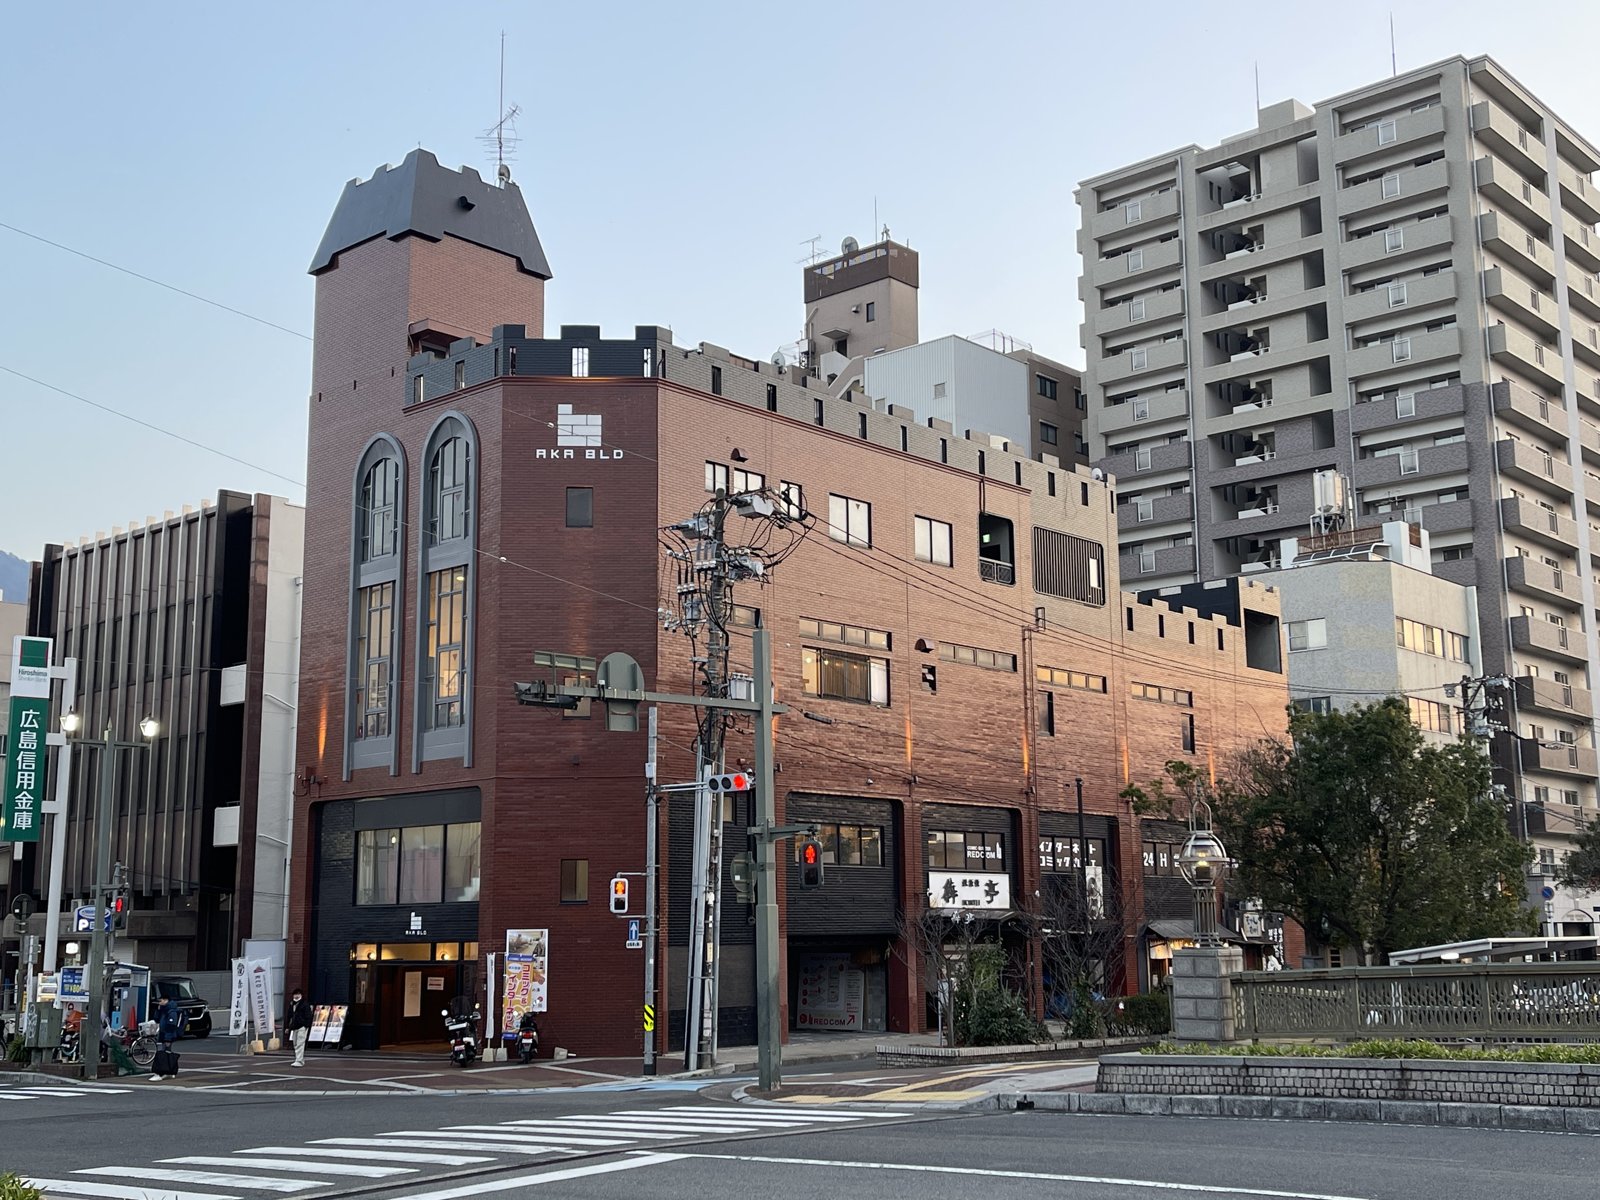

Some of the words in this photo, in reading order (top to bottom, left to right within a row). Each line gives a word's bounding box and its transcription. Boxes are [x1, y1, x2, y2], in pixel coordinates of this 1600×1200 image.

[536, 449, 574, 459] AKA
[585, 449, 624, 460] BLD
[19, 669, 48, 677] Hiroshima
[13, 709, 41, 830] 広島信用金庫
[967, 850, 996, 859] REDCOM
[78, 918, 90, 931] P
[505, 974, 518, 1031] インターネット
